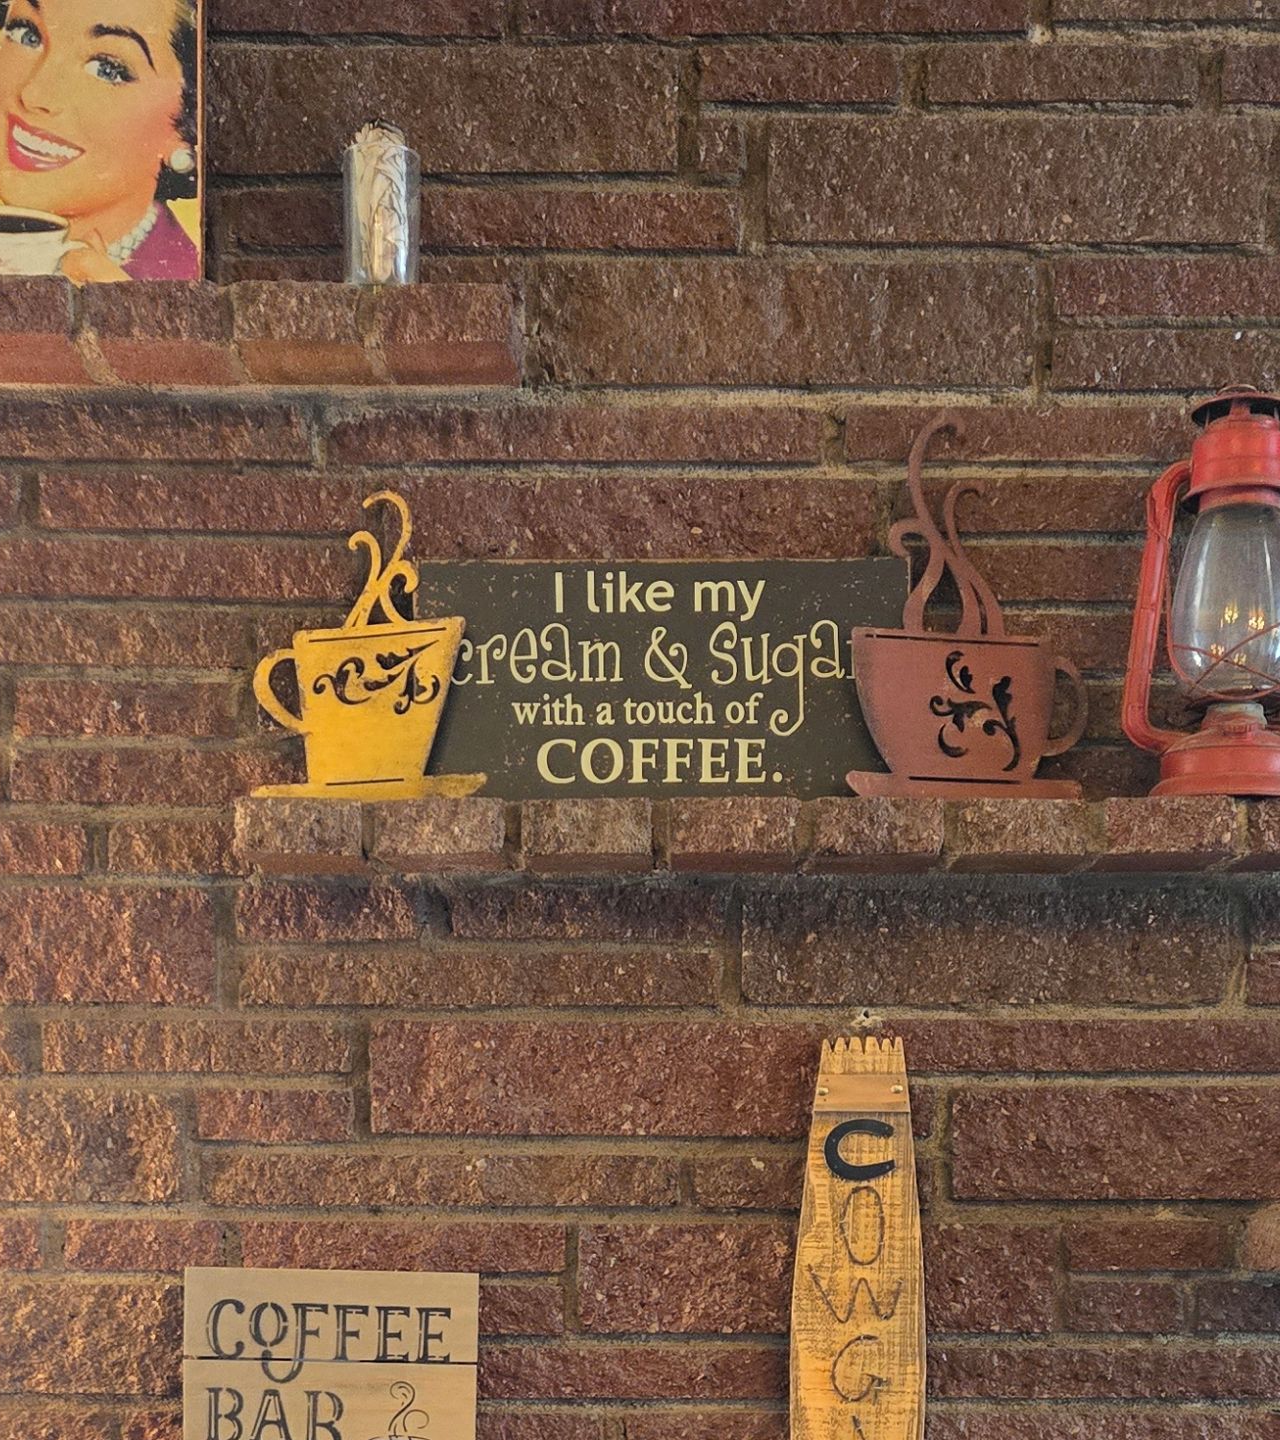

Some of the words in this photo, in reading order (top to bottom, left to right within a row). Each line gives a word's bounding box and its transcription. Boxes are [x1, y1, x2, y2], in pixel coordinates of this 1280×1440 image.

[554, 571, 564, 613] I
[586, 570, 675, 613] like
[694, 579, 766, 622] my
[643, 626, 693, 689] &
[708, 619, 858, 737] Suga
[511, 693, 586, 725] with
[595, 701, 616, 725] a
[623, 691, 716, 725] touch
[725, 691, 764, 725] of
[536, 738, 783, 784] COFFEE.
[205, 1299, 452, 1384] COFFEE
